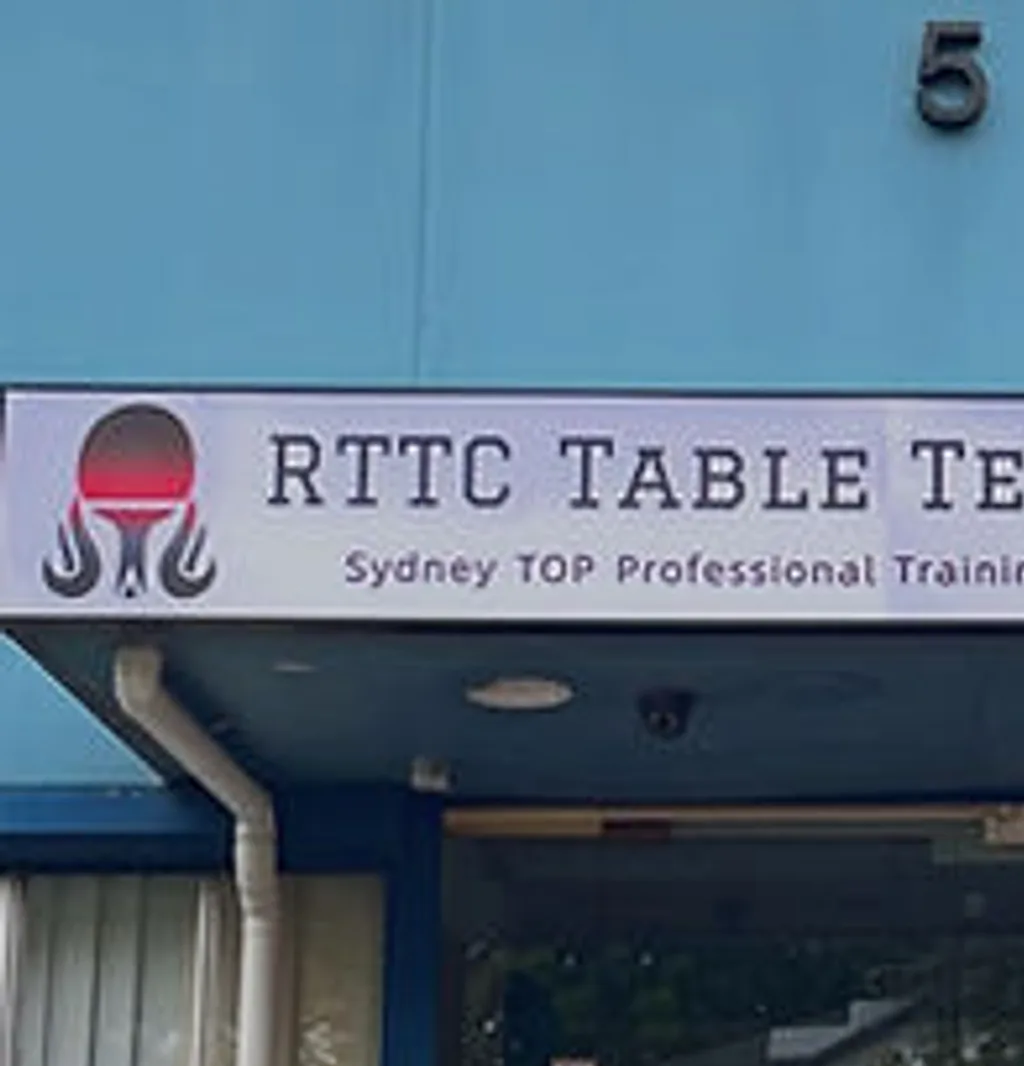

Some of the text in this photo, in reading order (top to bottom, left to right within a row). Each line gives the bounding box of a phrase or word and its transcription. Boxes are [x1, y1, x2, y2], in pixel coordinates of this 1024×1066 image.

[917, 20, 988, 134] 5
[267, 433, 511, 509] RTTC
[558, 435, 869, 511] TABLE
[344, 549, 498, 590] Sydney
[515, 552, 595, 585] TOP
[616, 550, 876, 589] Professional
